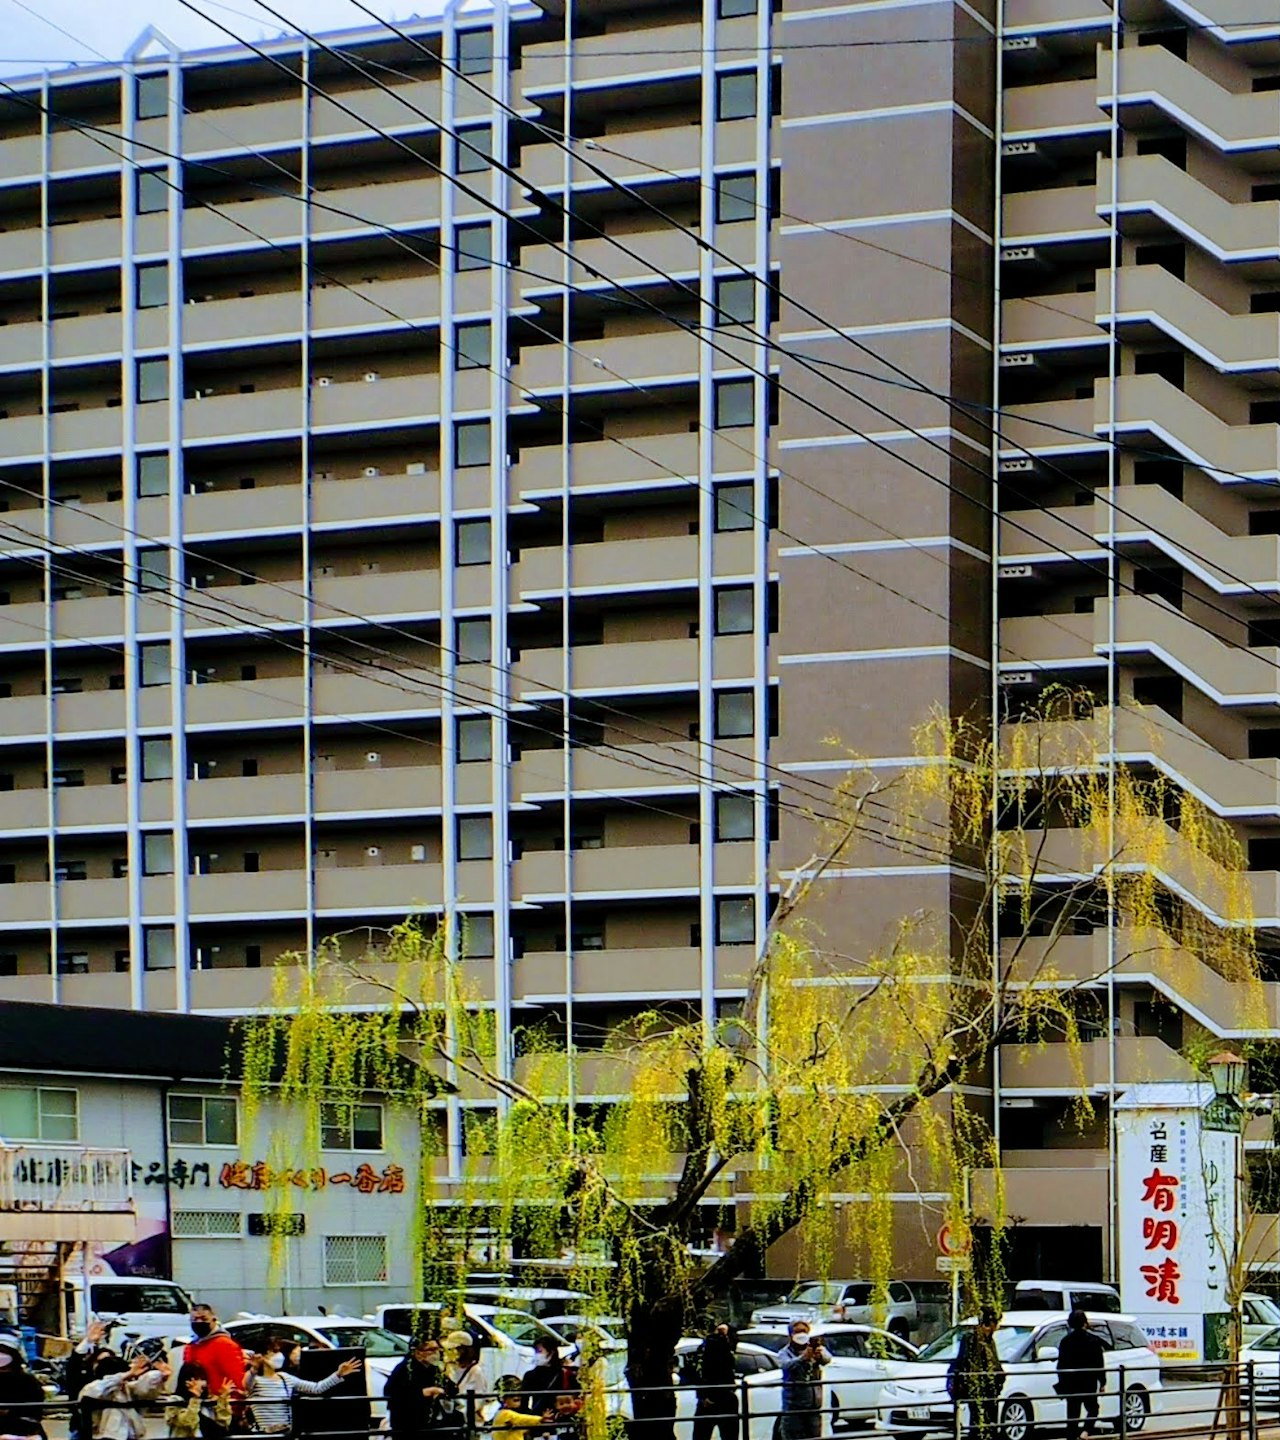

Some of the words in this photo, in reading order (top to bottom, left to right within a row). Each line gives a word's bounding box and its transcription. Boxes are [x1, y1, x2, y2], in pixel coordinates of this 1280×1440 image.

[1149, 1121, 1168, 1163] 名産
[1140, 1167, 1180, 1304] 有明漬
